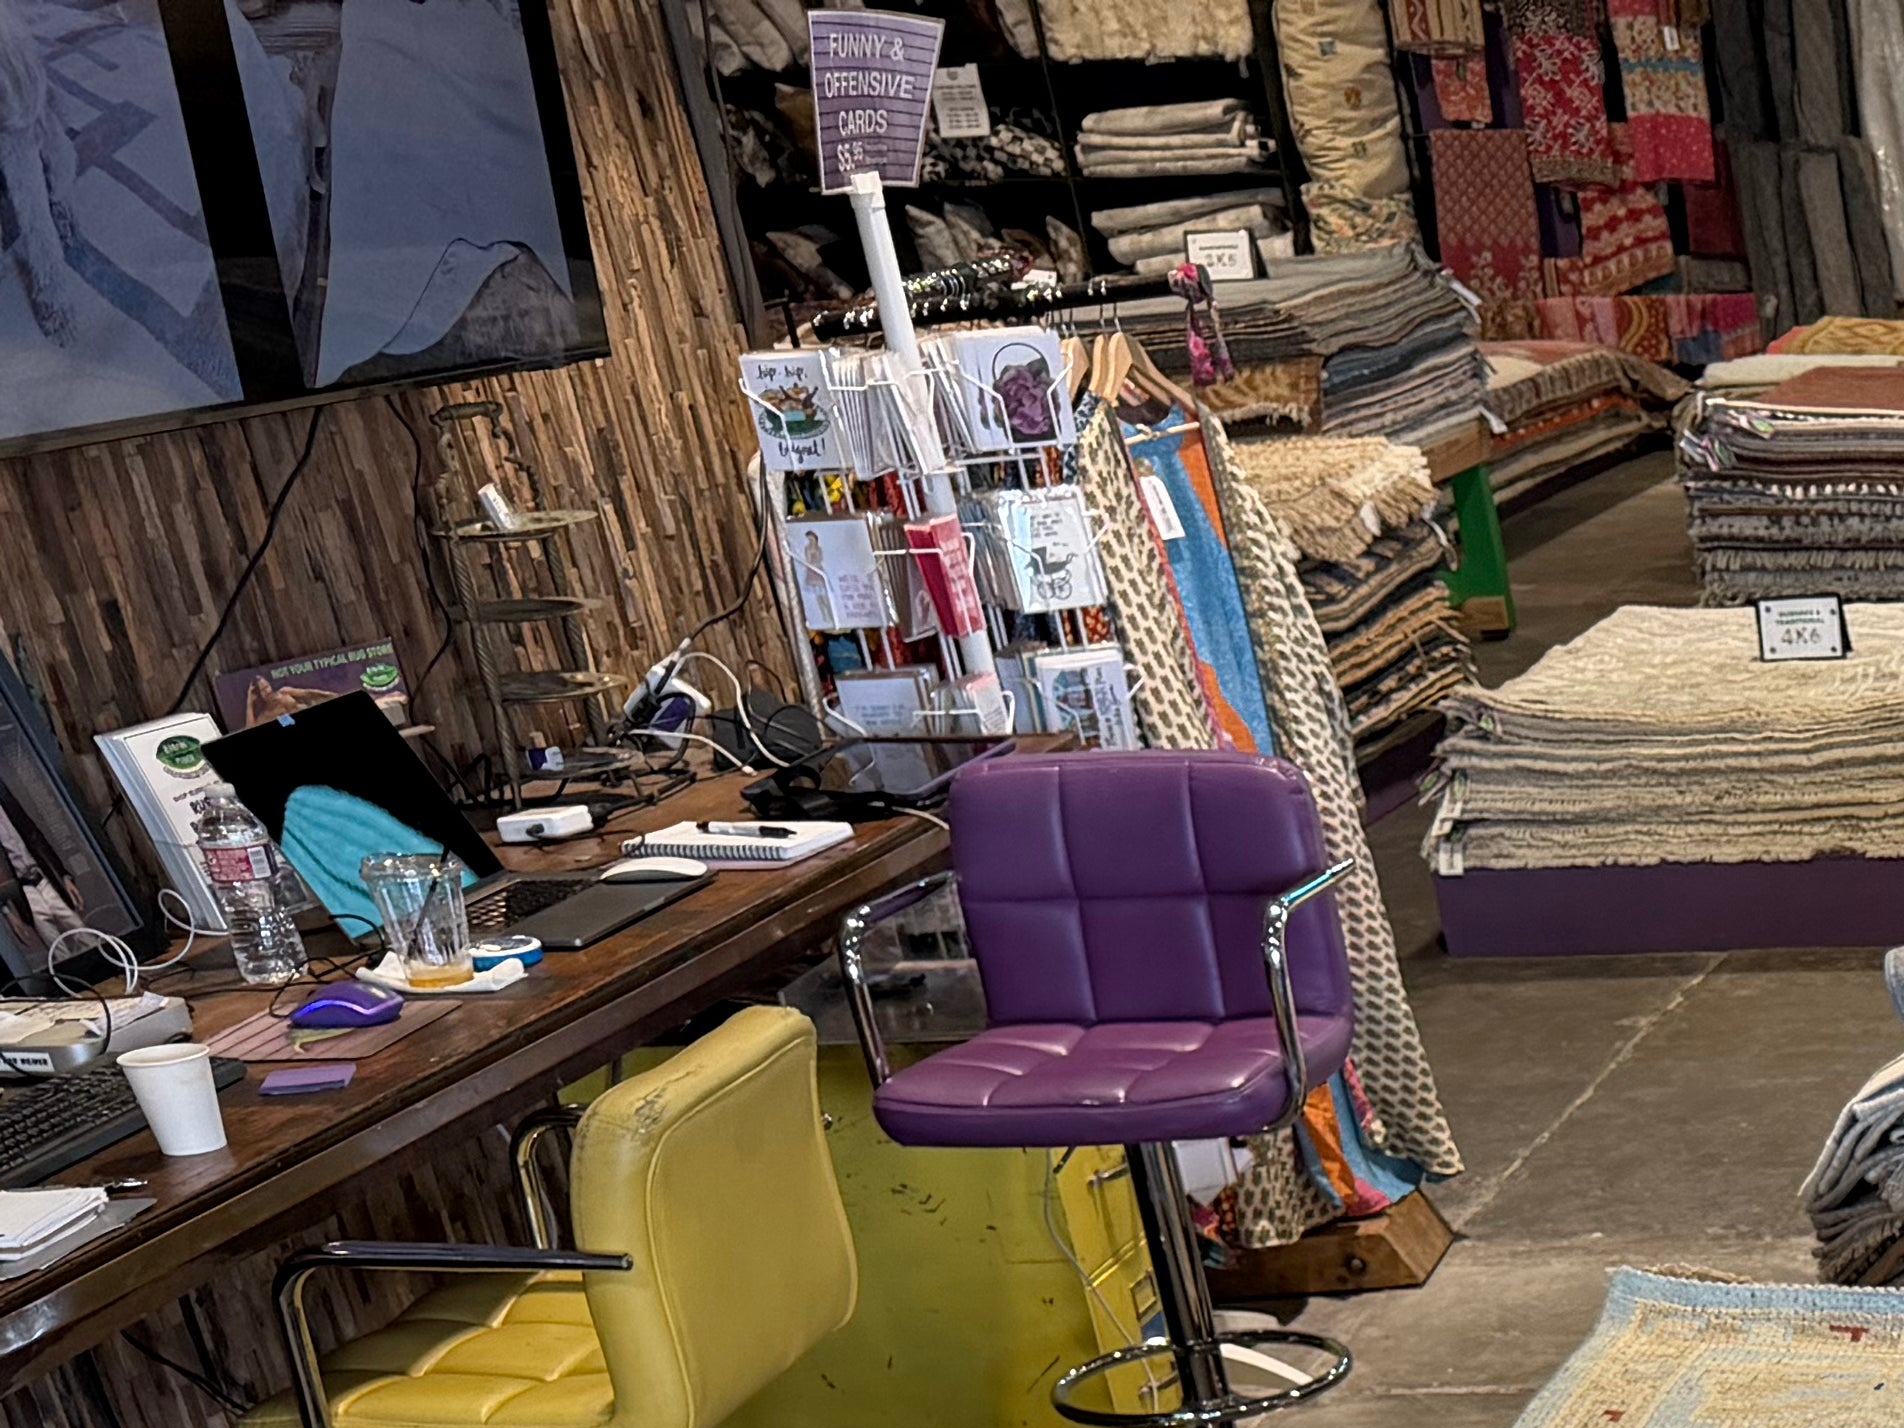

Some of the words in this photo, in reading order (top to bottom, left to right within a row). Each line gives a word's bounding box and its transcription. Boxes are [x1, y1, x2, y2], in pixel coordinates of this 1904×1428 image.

[829, 32, 886, 60] FUNNY
[890, 37, 905, 61] &
[824, 70, 916, 99] OFFENSIVE
[838, 109, 888, 137] CARDS
[1781, 627, 1821, 646] 4X6
[313, 653, 348, 671] TYPICAL
